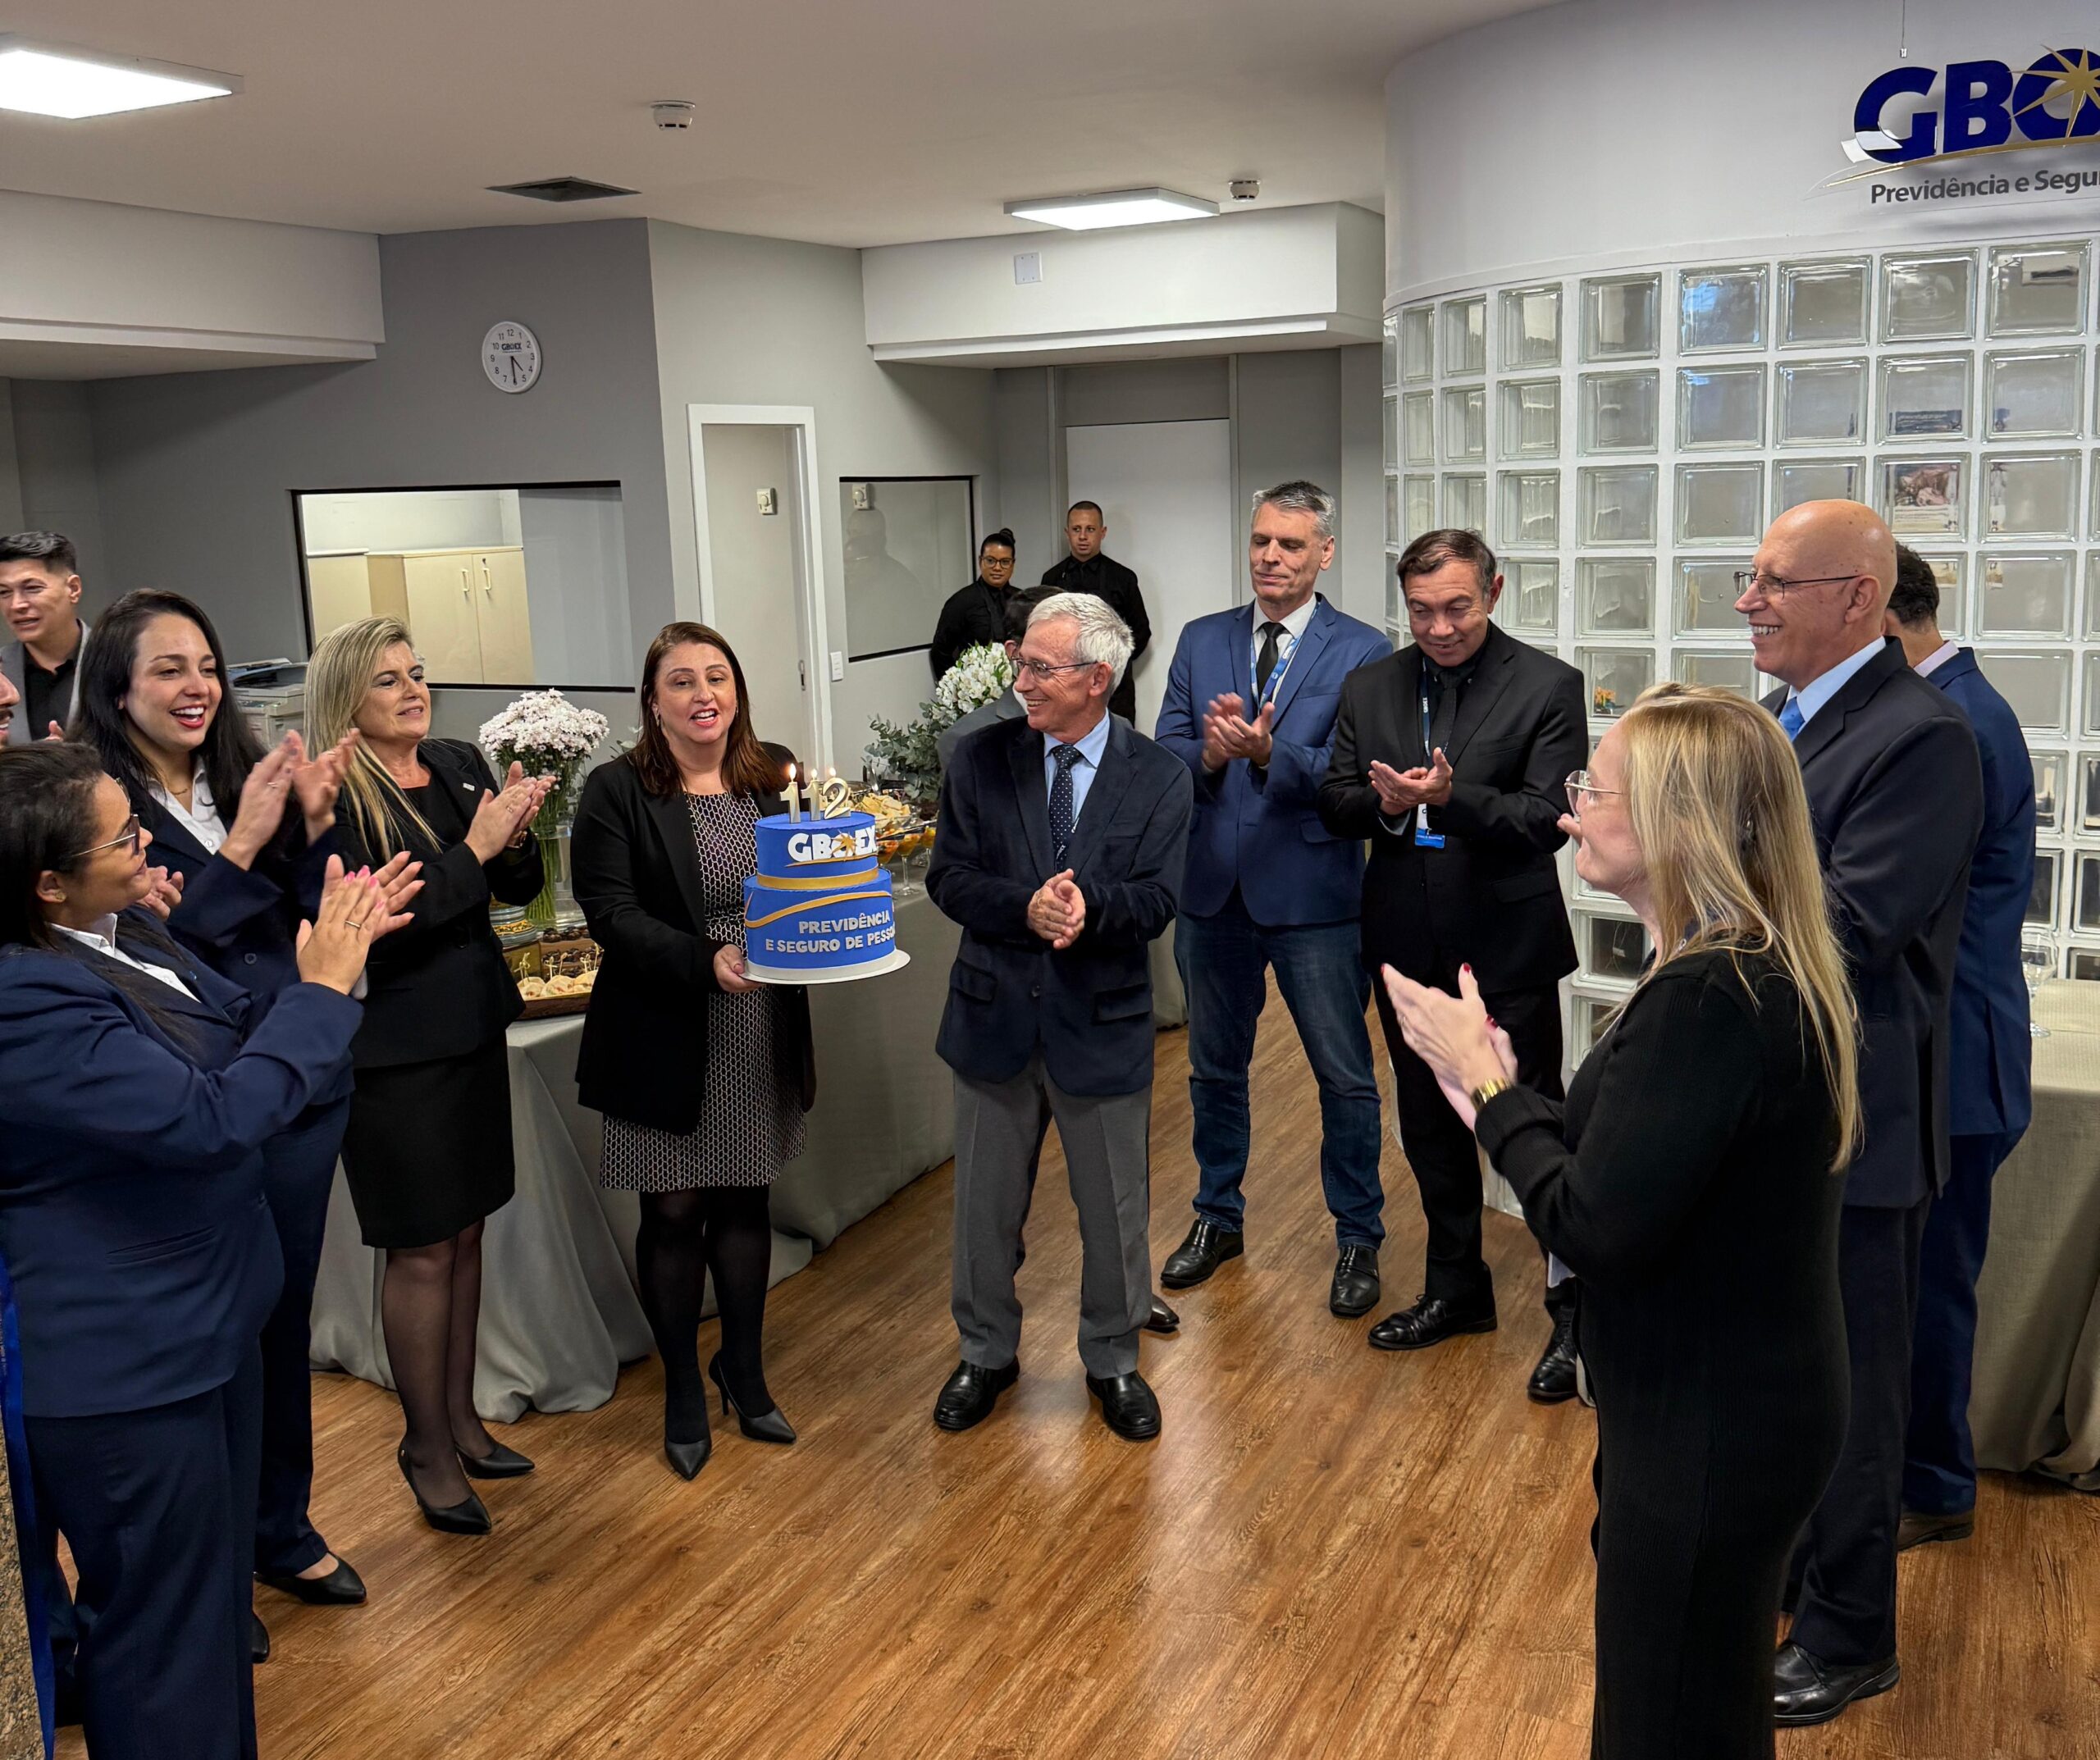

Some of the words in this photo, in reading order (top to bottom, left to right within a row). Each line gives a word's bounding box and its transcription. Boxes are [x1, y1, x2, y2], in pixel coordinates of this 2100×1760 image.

[1871, 174, 2010, 203] Previdência
[2015, 176, 2029, 193] e
[2034, 170, 2100, 194] Segu
[507, 329, 514, 337] 12
[527, 340, 532, 349] 2
[530, 353, 535, 361] 3
[779, 777, 851, 824] 112
[788, 825, 878, 862] GBOEX
[798, 910, 890, 934] PREVIDÊNCIA
[765, 938, 774, 951] E
[777, 938, 841, 953] SEGURO
[845, 935, 864, 950] DE
[867, 922, 896, 946] PESSO
